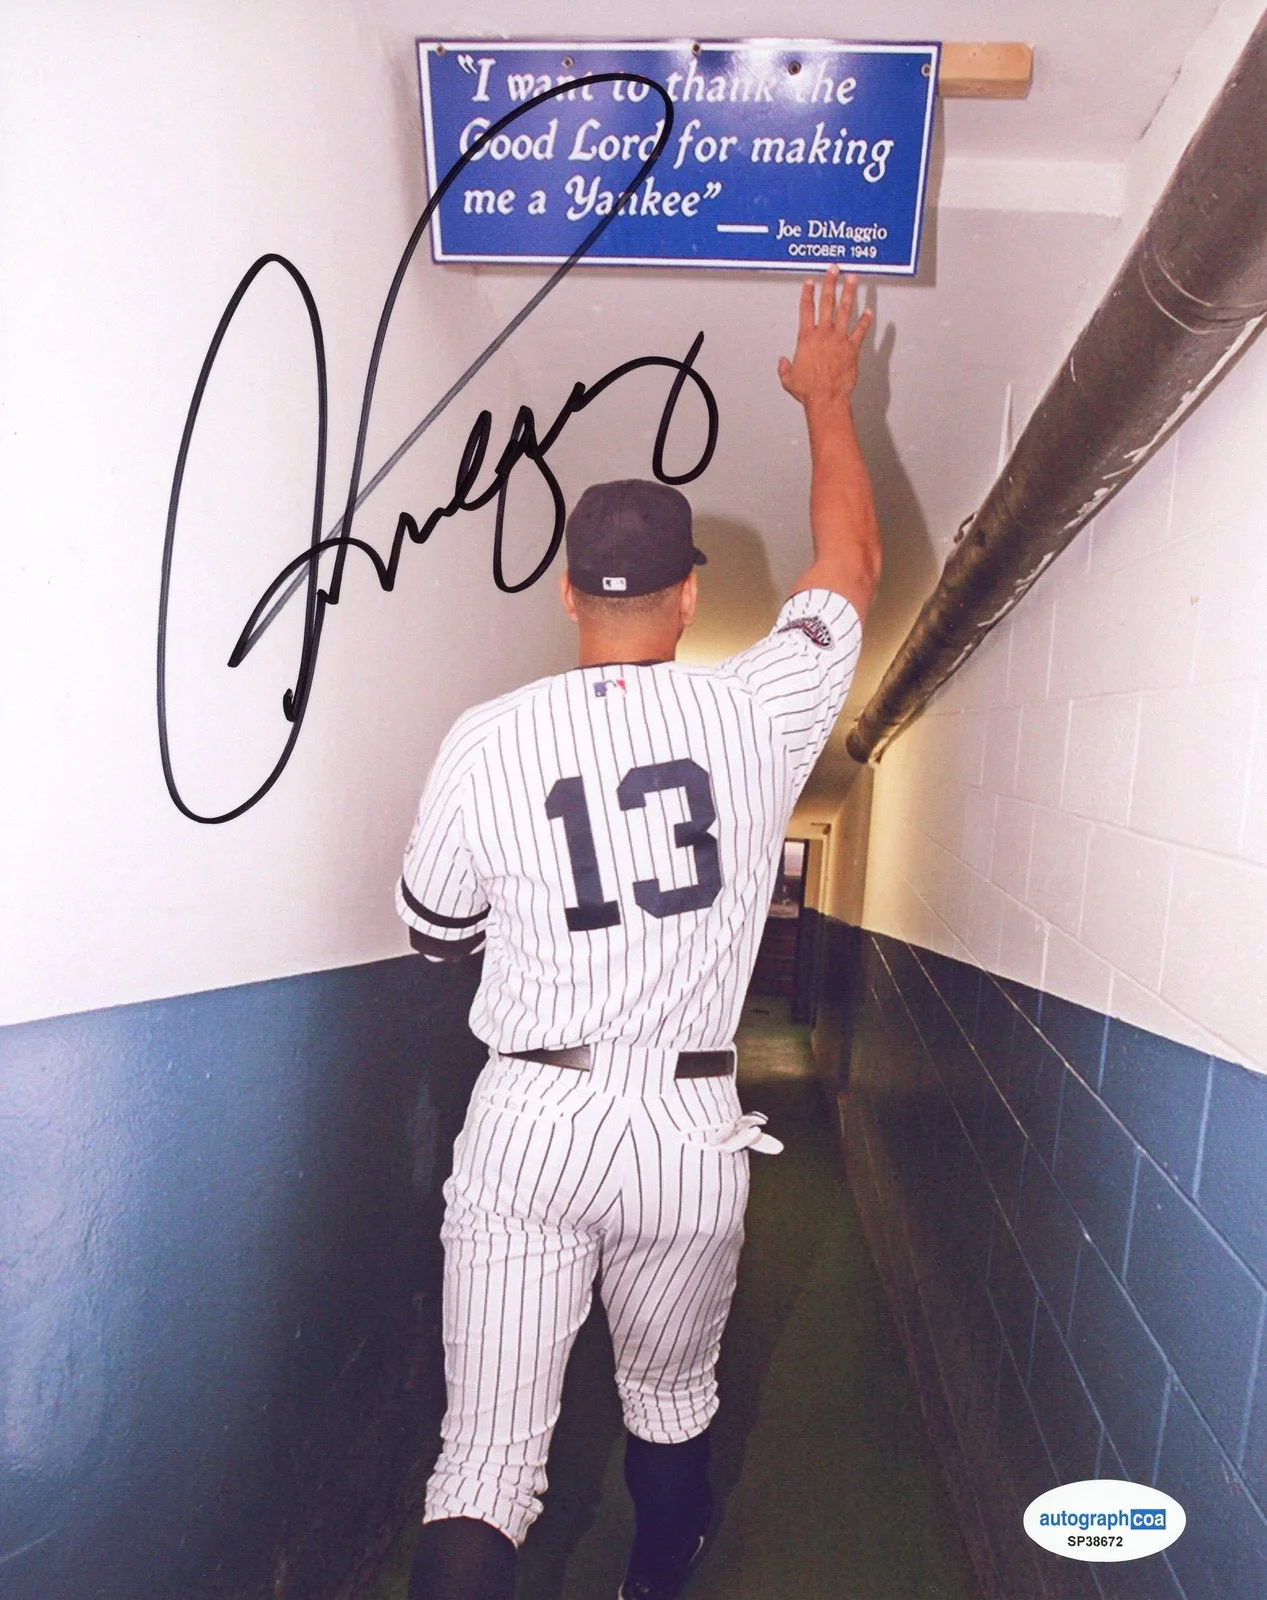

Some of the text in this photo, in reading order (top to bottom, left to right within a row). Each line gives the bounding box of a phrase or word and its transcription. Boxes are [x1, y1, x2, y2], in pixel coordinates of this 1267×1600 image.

[507, 72, 593, 102] want
[666, 58, 777, 102] thank
[459, 117, 894, 183] Good Lord for making
[463, 189, 516, 215] me
[527, 189, 547, 215] a
[776, 219, 888, 242] Joe DiMaggio
[788, 243, 877, 258] OCTOBER 1949
[544, 757, 723, 932] 13
